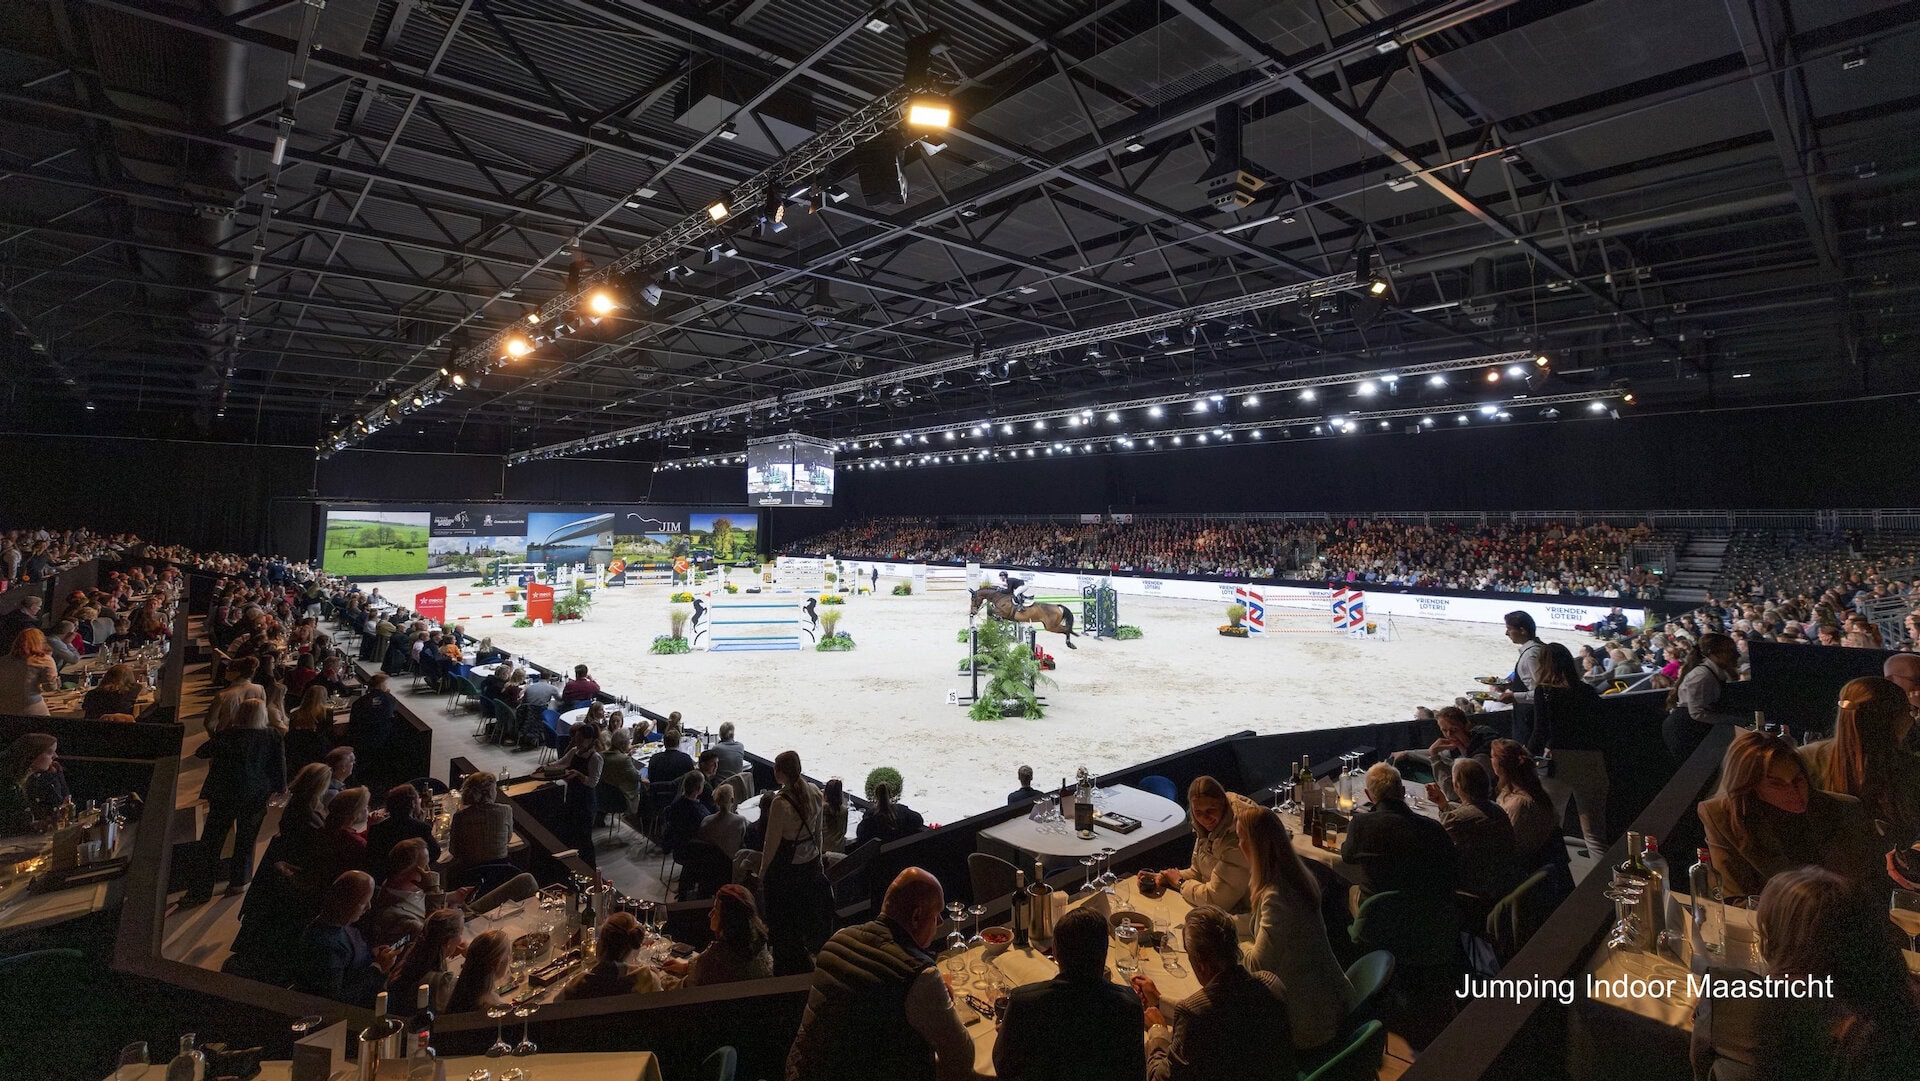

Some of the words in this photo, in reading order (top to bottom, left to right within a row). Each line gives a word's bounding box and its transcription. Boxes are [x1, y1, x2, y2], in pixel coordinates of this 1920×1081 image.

[659, 522, 681, 532] JIM
[1545, 606, 1587, 614] VRIENDEN
[1551, 613, 1582, 621] LOTERIJ
